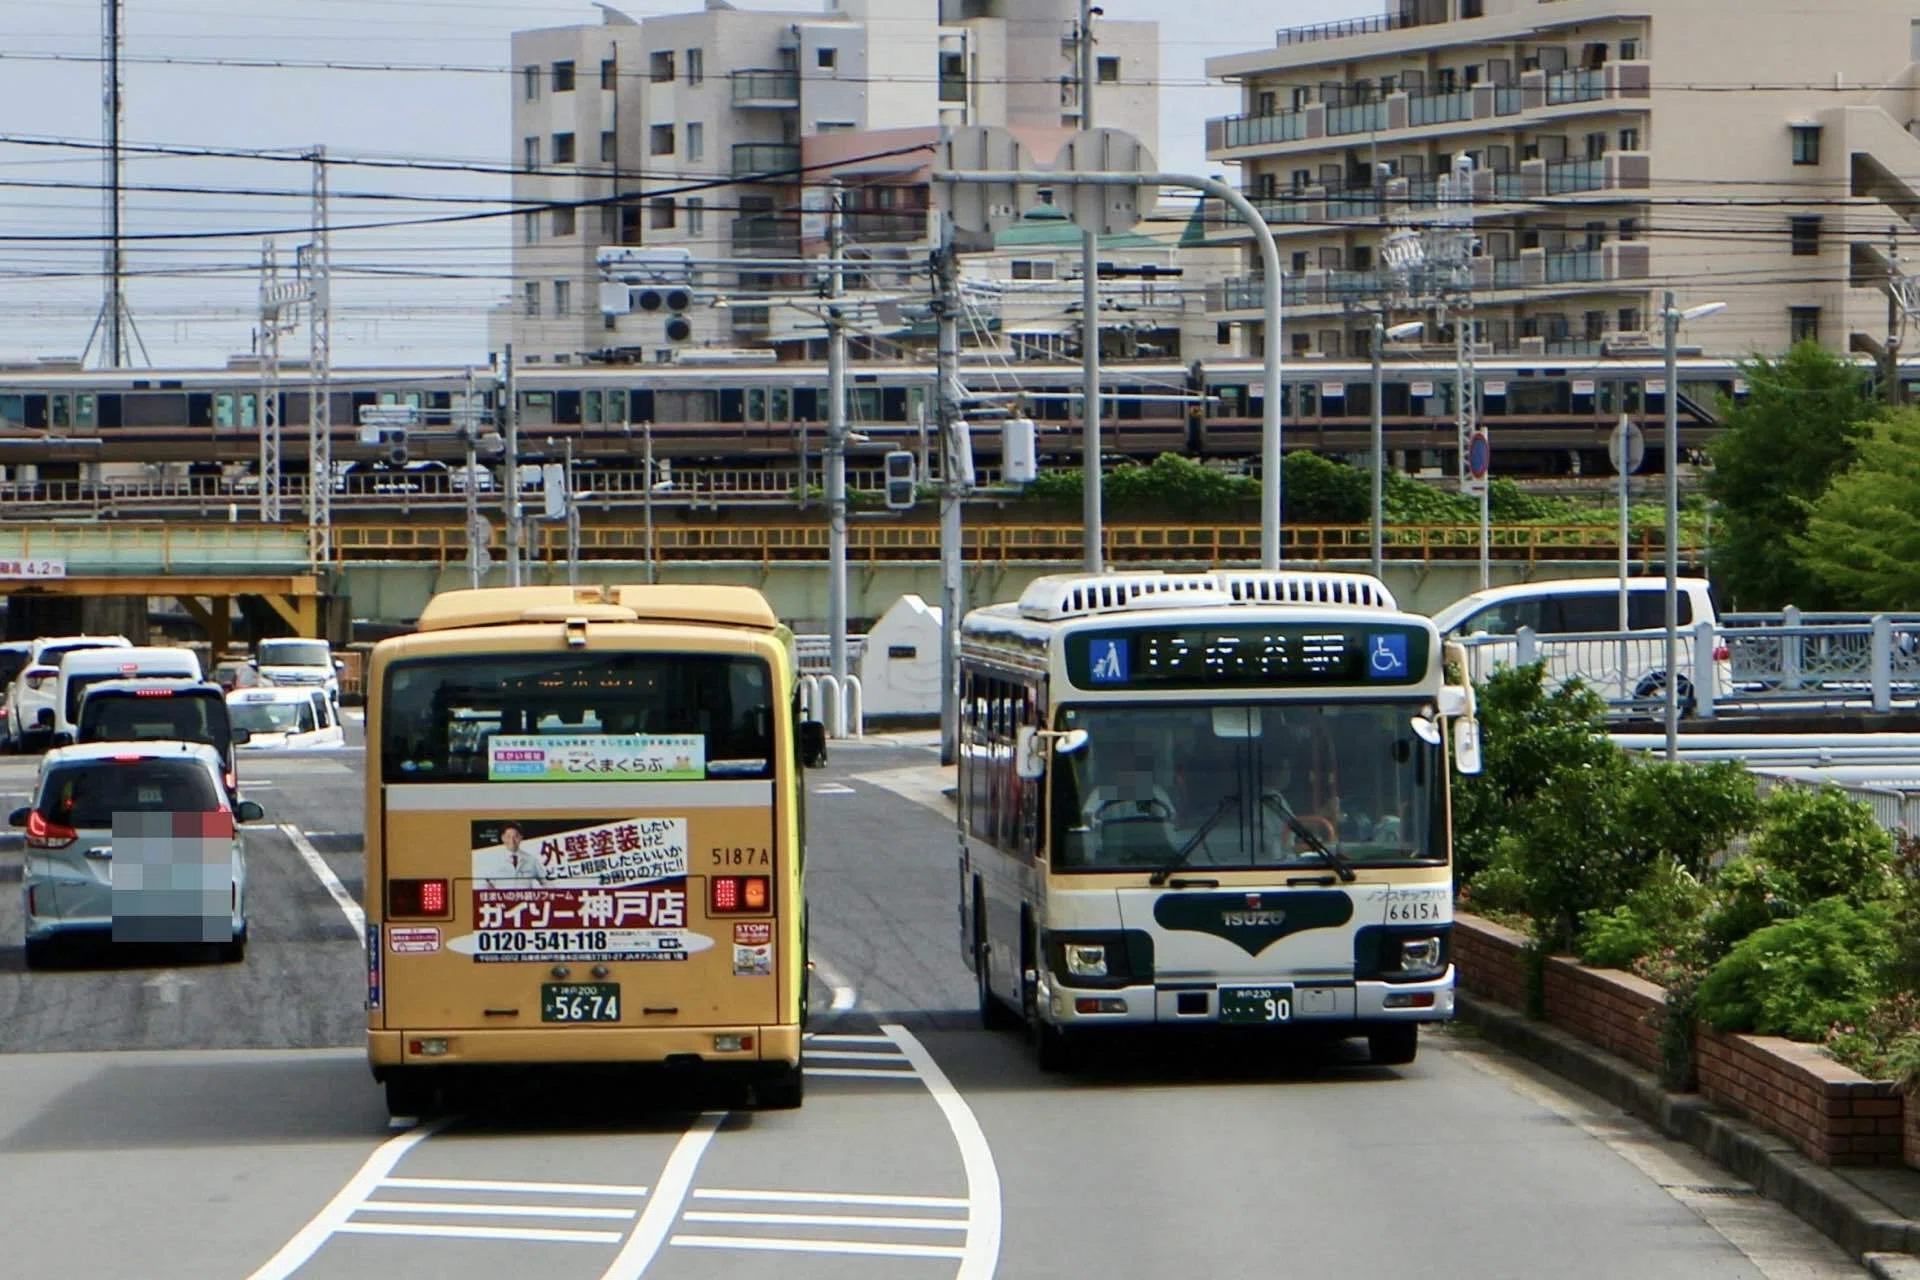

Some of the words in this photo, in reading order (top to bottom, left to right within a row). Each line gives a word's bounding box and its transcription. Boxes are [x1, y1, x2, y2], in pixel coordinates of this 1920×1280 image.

[567, 757, 664, 773] こぐまくらぶ
[641, 819, 675, 834] したい
[540, 824, 641, 866] 外壁塗装
[544, 845, 682, 881] どこに相談したらいいか
[712, 848, 769, 865] 5187A
[1223, 910, 1286, 926] ISUZU
[1390, 903, 1440, 919] 6615A
[478, 931, 607, 951] 0120-541-118
[555, 995, 618, 1020] 56-74
